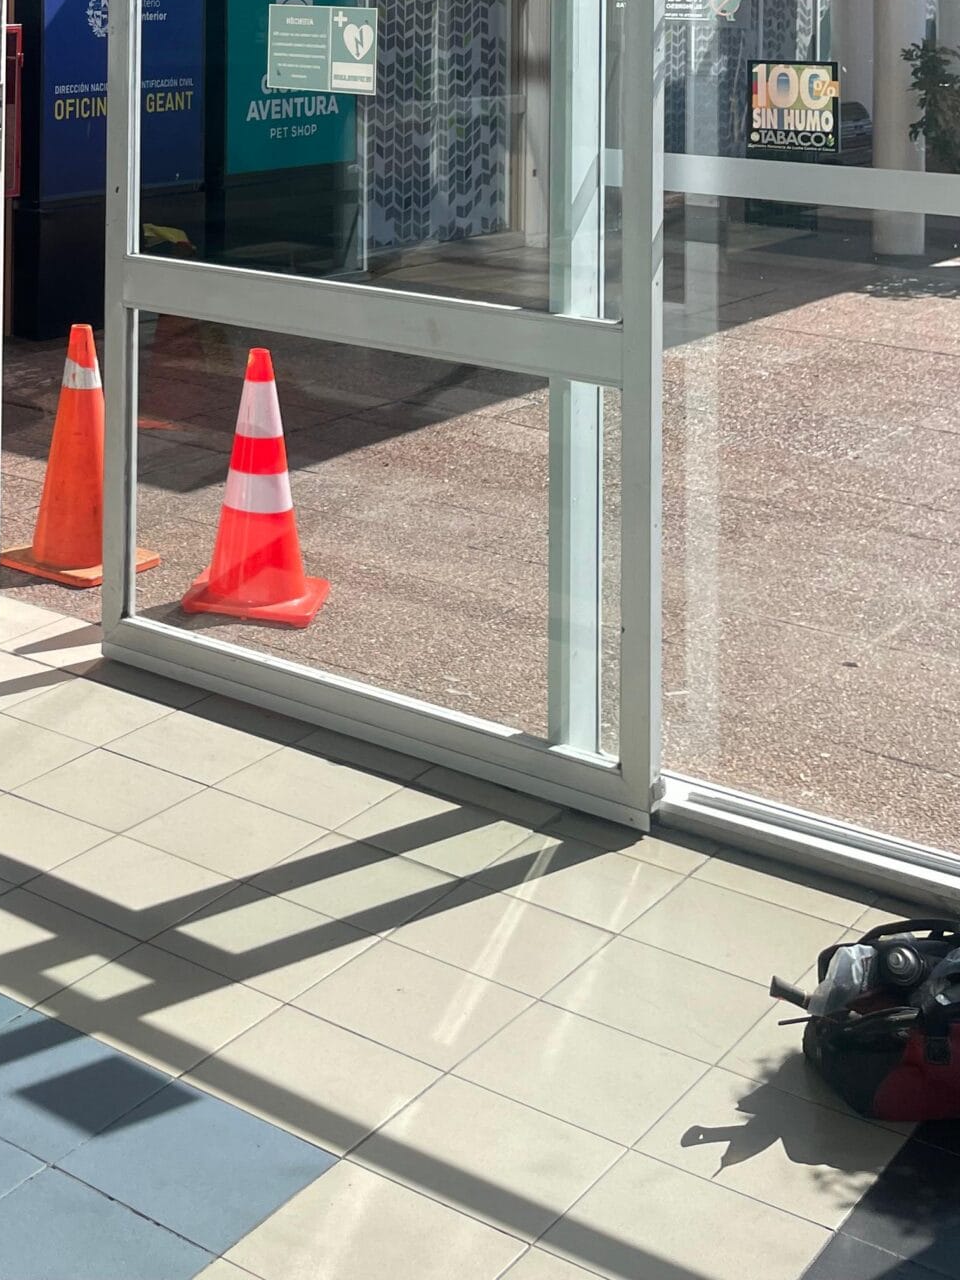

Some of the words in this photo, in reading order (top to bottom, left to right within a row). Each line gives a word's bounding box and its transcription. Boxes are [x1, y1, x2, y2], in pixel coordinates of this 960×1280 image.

[54, 83, 90, 95] DIRECCIÓN
[54, 97, 107, 120] OFICIN
[146, 91, 194, 113] GEANT
[246, 95, 339, 121] AVENTURA
[752, 107, 778, 129] SIN
[783, 108, 834, 132] HUMO
[270, 126, 288, 139] PET
[291, 124, 317, 137] SHOP
[759, 129, 826, 147] TABACO
